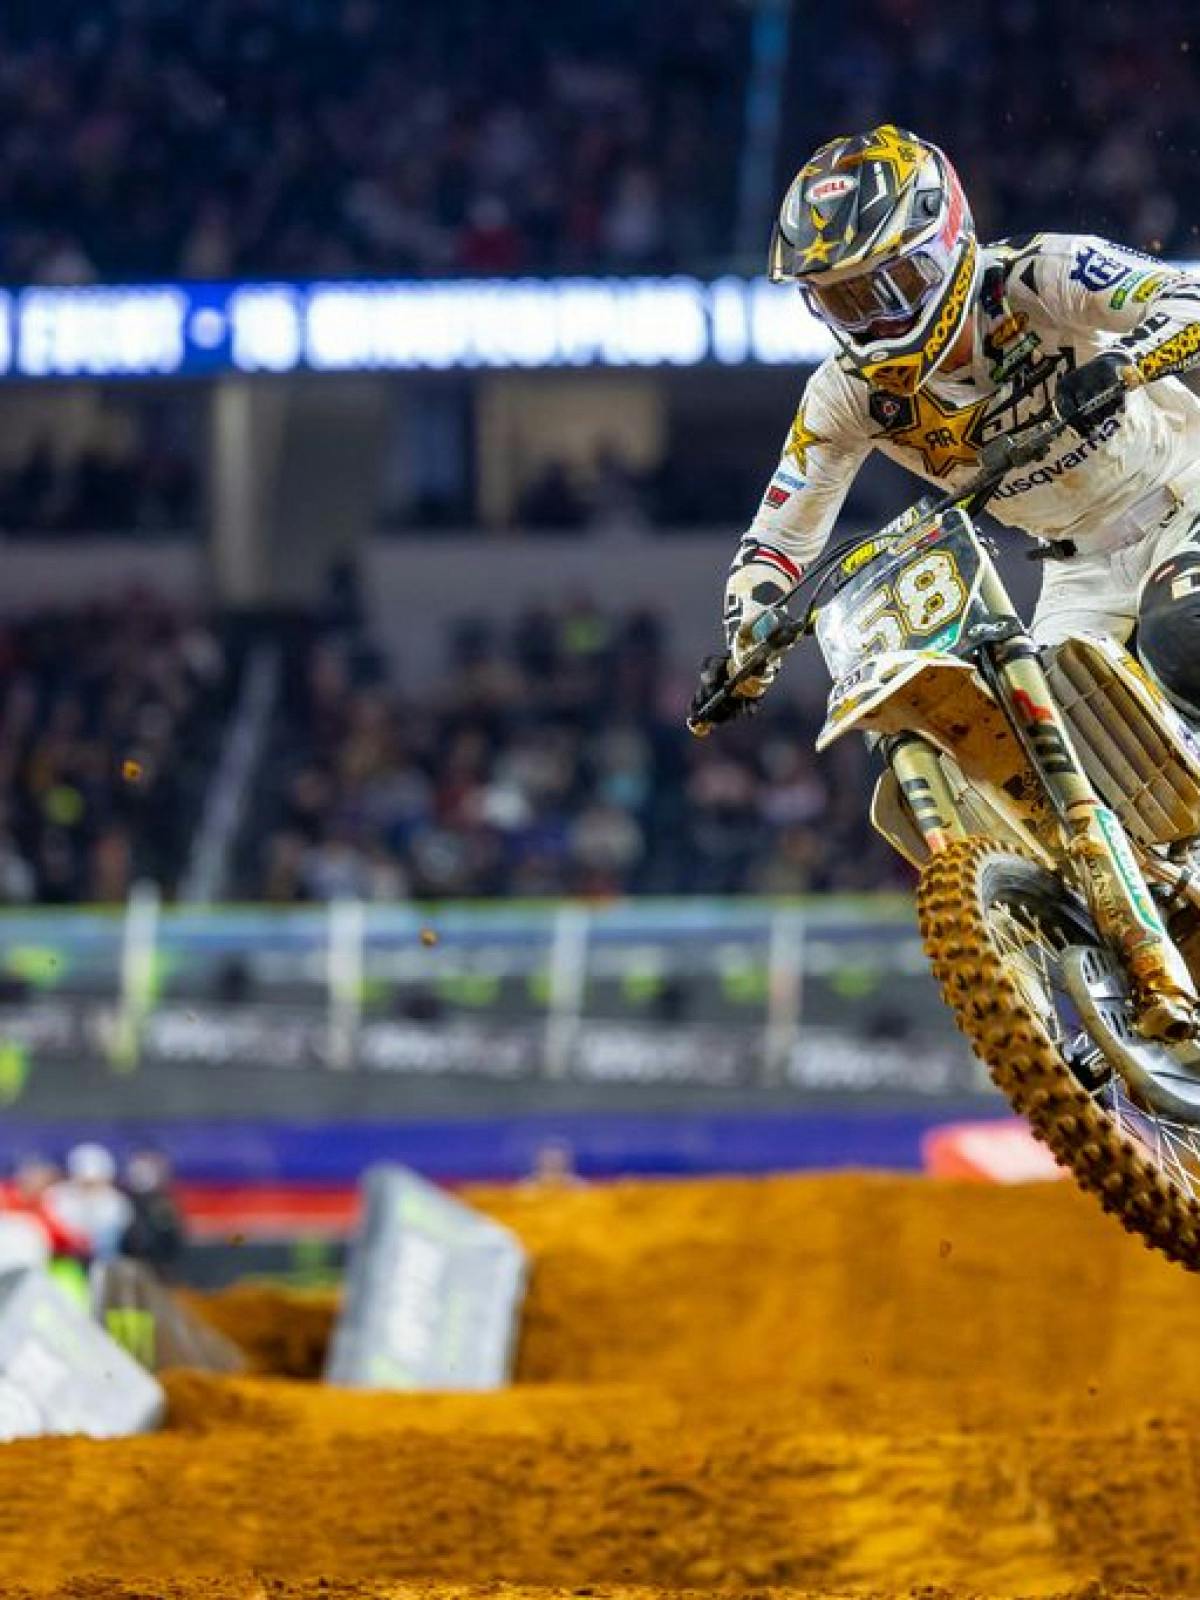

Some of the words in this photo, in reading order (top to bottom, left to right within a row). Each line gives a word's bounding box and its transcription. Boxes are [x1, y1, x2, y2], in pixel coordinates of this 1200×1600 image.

[811, 179, 848, 198] BELL
[991, 417, 1122, 500] usqvarna
[852, 550, 968, 657] 58
